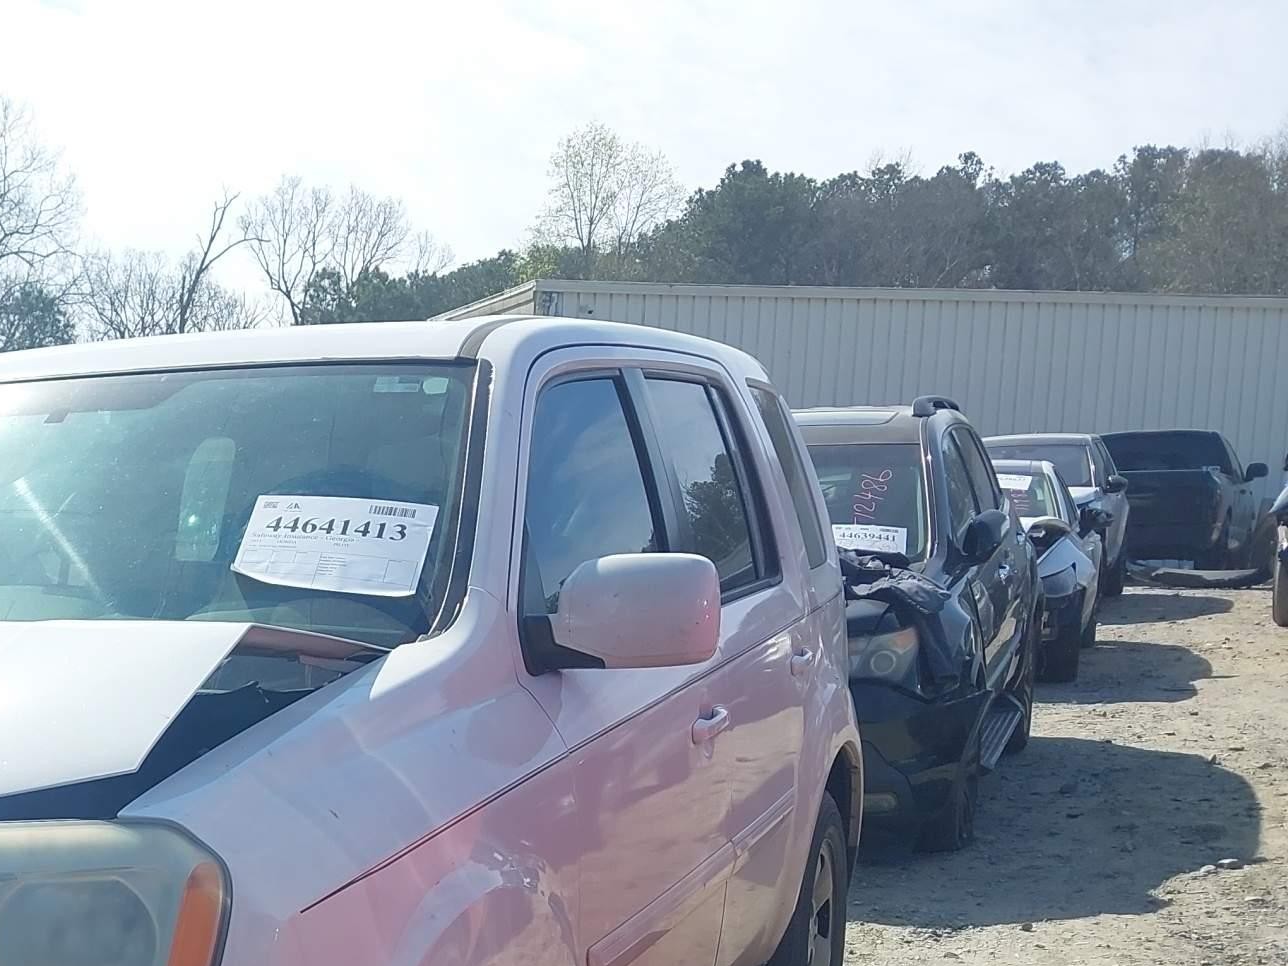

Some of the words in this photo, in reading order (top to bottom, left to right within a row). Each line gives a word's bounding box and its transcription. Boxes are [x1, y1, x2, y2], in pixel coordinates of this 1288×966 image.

[265, 516, 408, 541] 44641413
[284, 533, 319, 541] Insurance
[325, 535, 355, 543] Georgia
[839, 531, 896, 542] 44639441
